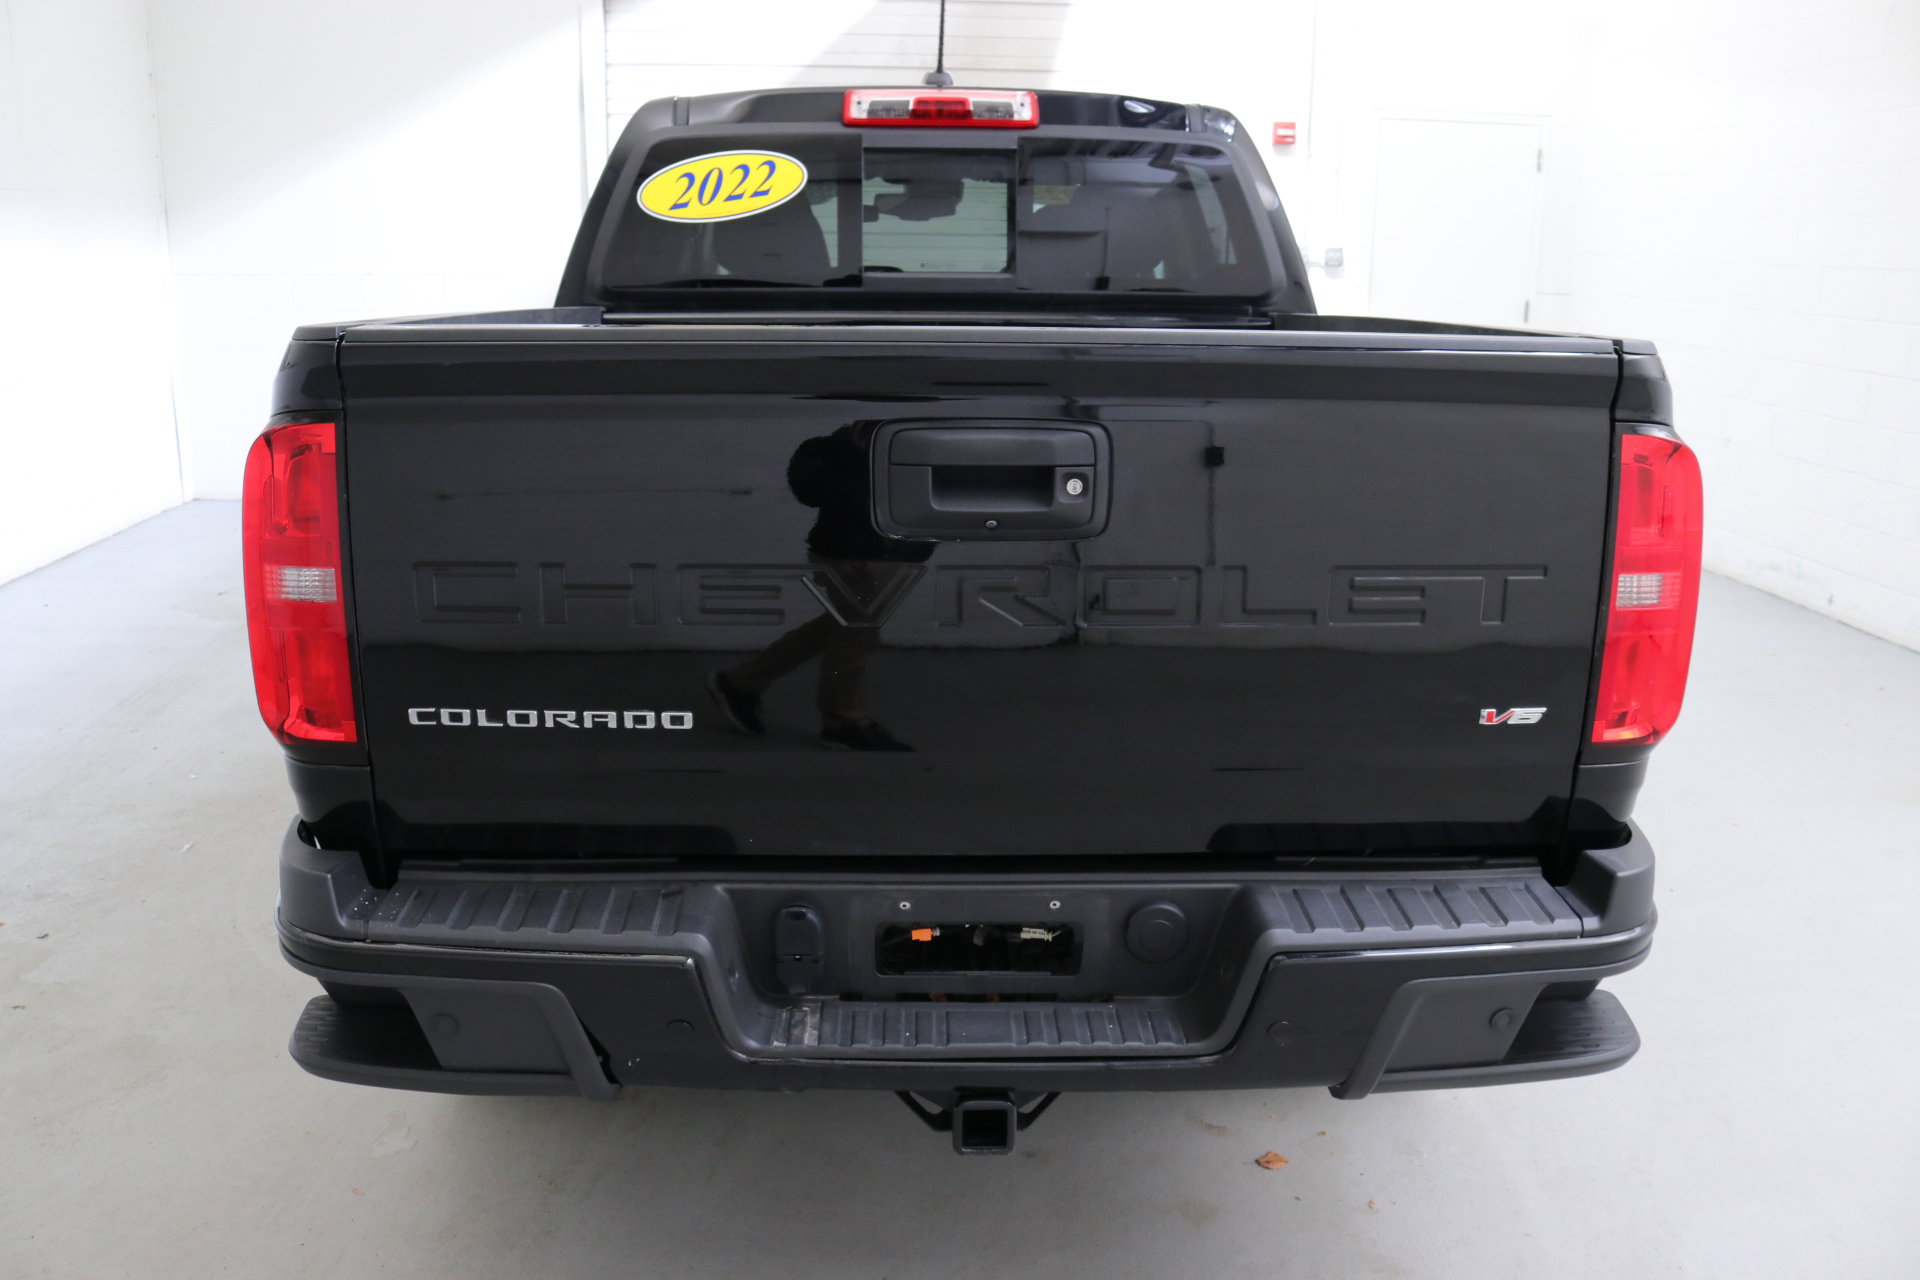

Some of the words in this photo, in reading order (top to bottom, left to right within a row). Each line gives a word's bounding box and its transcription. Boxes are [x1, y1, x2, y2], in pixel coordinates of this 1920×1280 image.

[668, 160, 777, 211] 2022
[414, 562, 1548, 626] CHEVROLET
[407, 707, 693, 729] COLORADO
[1479, 707, 1547, 725] V6
